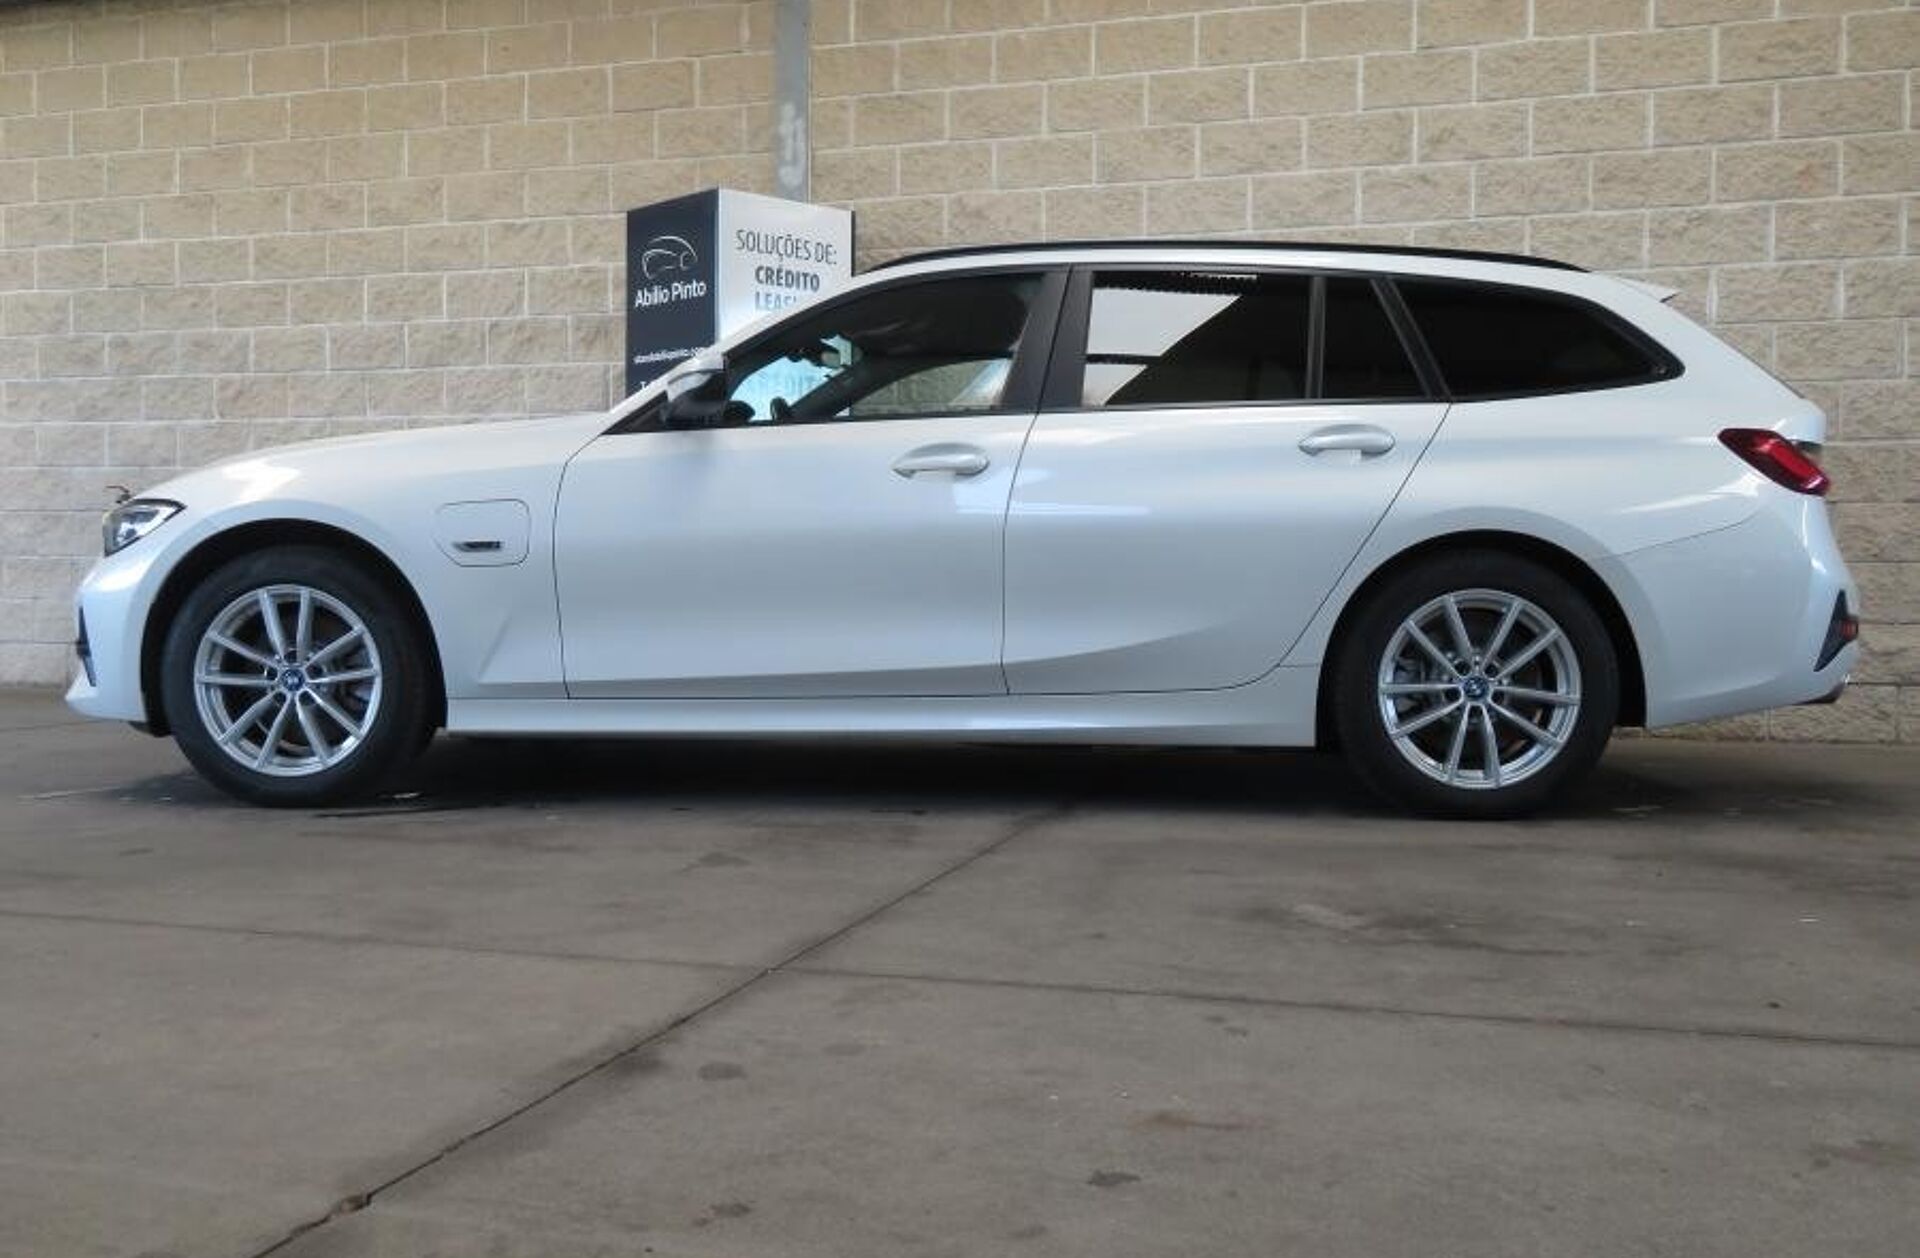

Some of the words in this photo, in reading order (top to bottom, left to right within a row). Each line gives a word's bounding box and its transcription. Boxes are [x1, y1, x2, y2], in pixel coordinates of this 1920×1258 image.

[736, 229, 811, 262] SOLUÇÕES
[815, 241, 838, 265] DE:
[671, 279, 707, 301] Pinto
[755, 264, 820, 292] CRÉDITO
